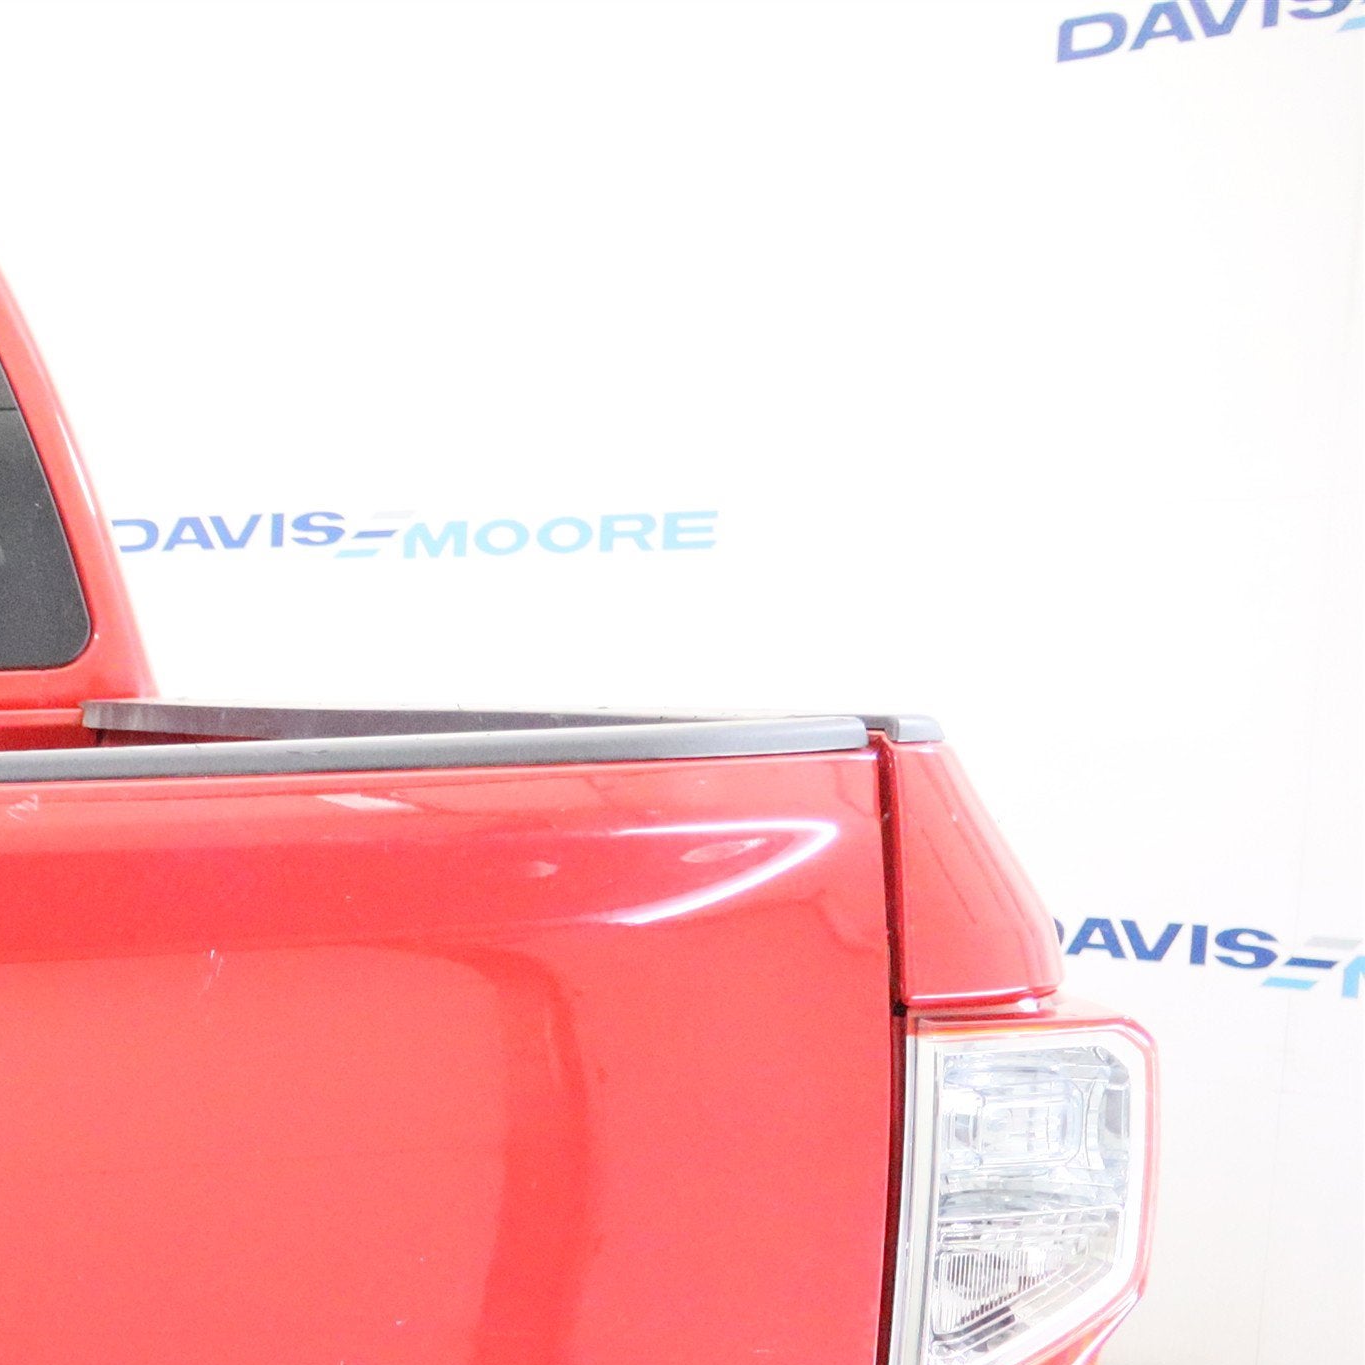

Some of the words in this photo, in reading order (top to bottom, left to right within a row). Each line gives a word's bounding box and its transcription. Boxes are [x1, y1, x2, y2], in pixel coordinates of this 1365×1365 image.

[110, 511, 346, 554] DAVIS
[402, 510, 719, 559] MOORE
[1053, 916, 1280, 970] AVIS
